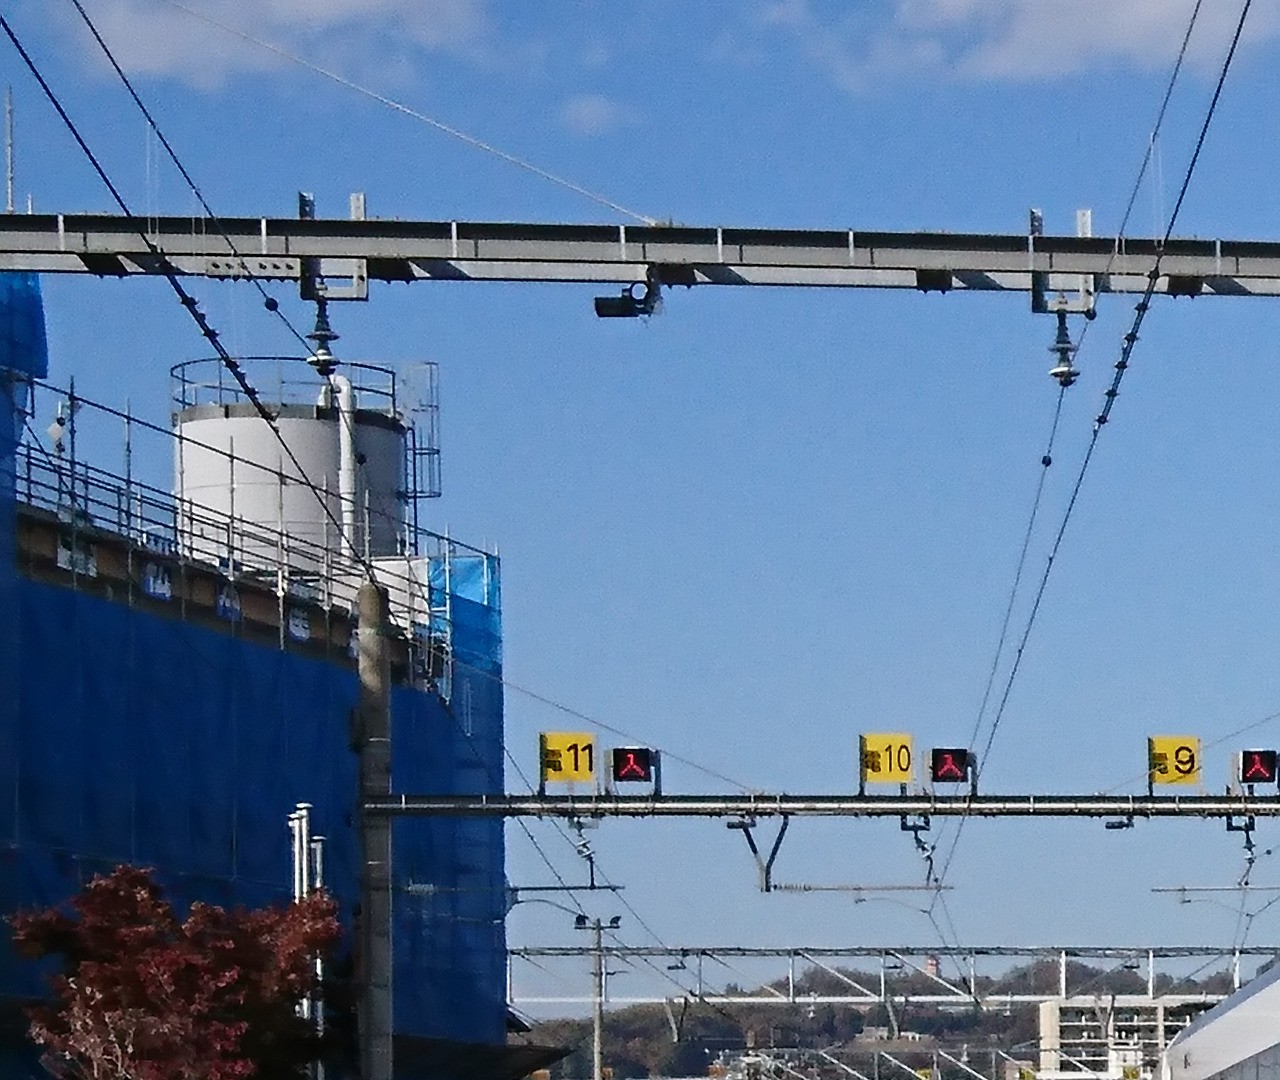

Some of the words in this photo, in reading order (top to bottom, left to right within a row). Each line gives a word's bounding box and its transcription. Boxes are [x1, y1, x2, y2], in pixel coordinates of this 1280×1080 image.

[566, 743, 594, 772] 11
[884, 744, 911, 773] 10
[1174, 745, 1195, 774] 9
